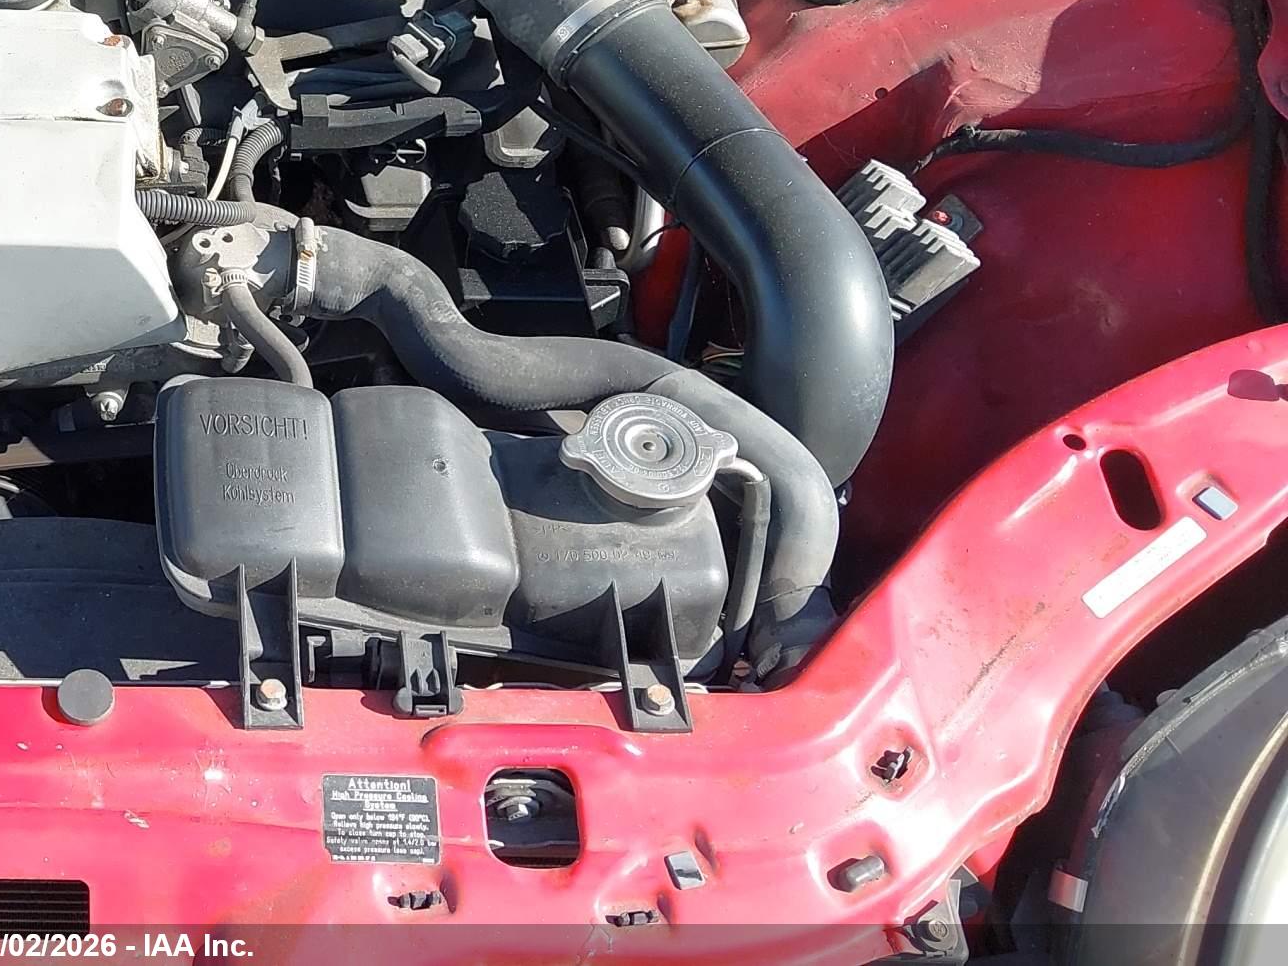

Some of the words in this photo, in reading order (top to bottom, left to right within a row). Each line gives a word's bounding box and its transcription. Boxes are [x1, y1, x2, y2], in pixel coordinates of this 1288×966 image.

[200, 413, 308, 440] VORSICHT!
[226, 458, 289, 481] Überdruck
[348, 778, 411, 791] Attention!
[332, 791, 350, 800] High
[354, 791, 392, 801] Pressure
[396, 792, 428, 802] Cooling
[364, 800, 397, 810] System
[331, 812, 346, 821] Open
[349, 813, 363, 822] only
[366, 813, 385, 821] below
[333, 820, 357, 829] Relieve
[360, 820, 373, 830] high
[376, 823, 403, 831] pressure
[337, 828, 345, 836] To
[369, 829, 382, 837] turn
[326, 837, 347, 846] Safety
[364, 847, 391, 855] pressure
